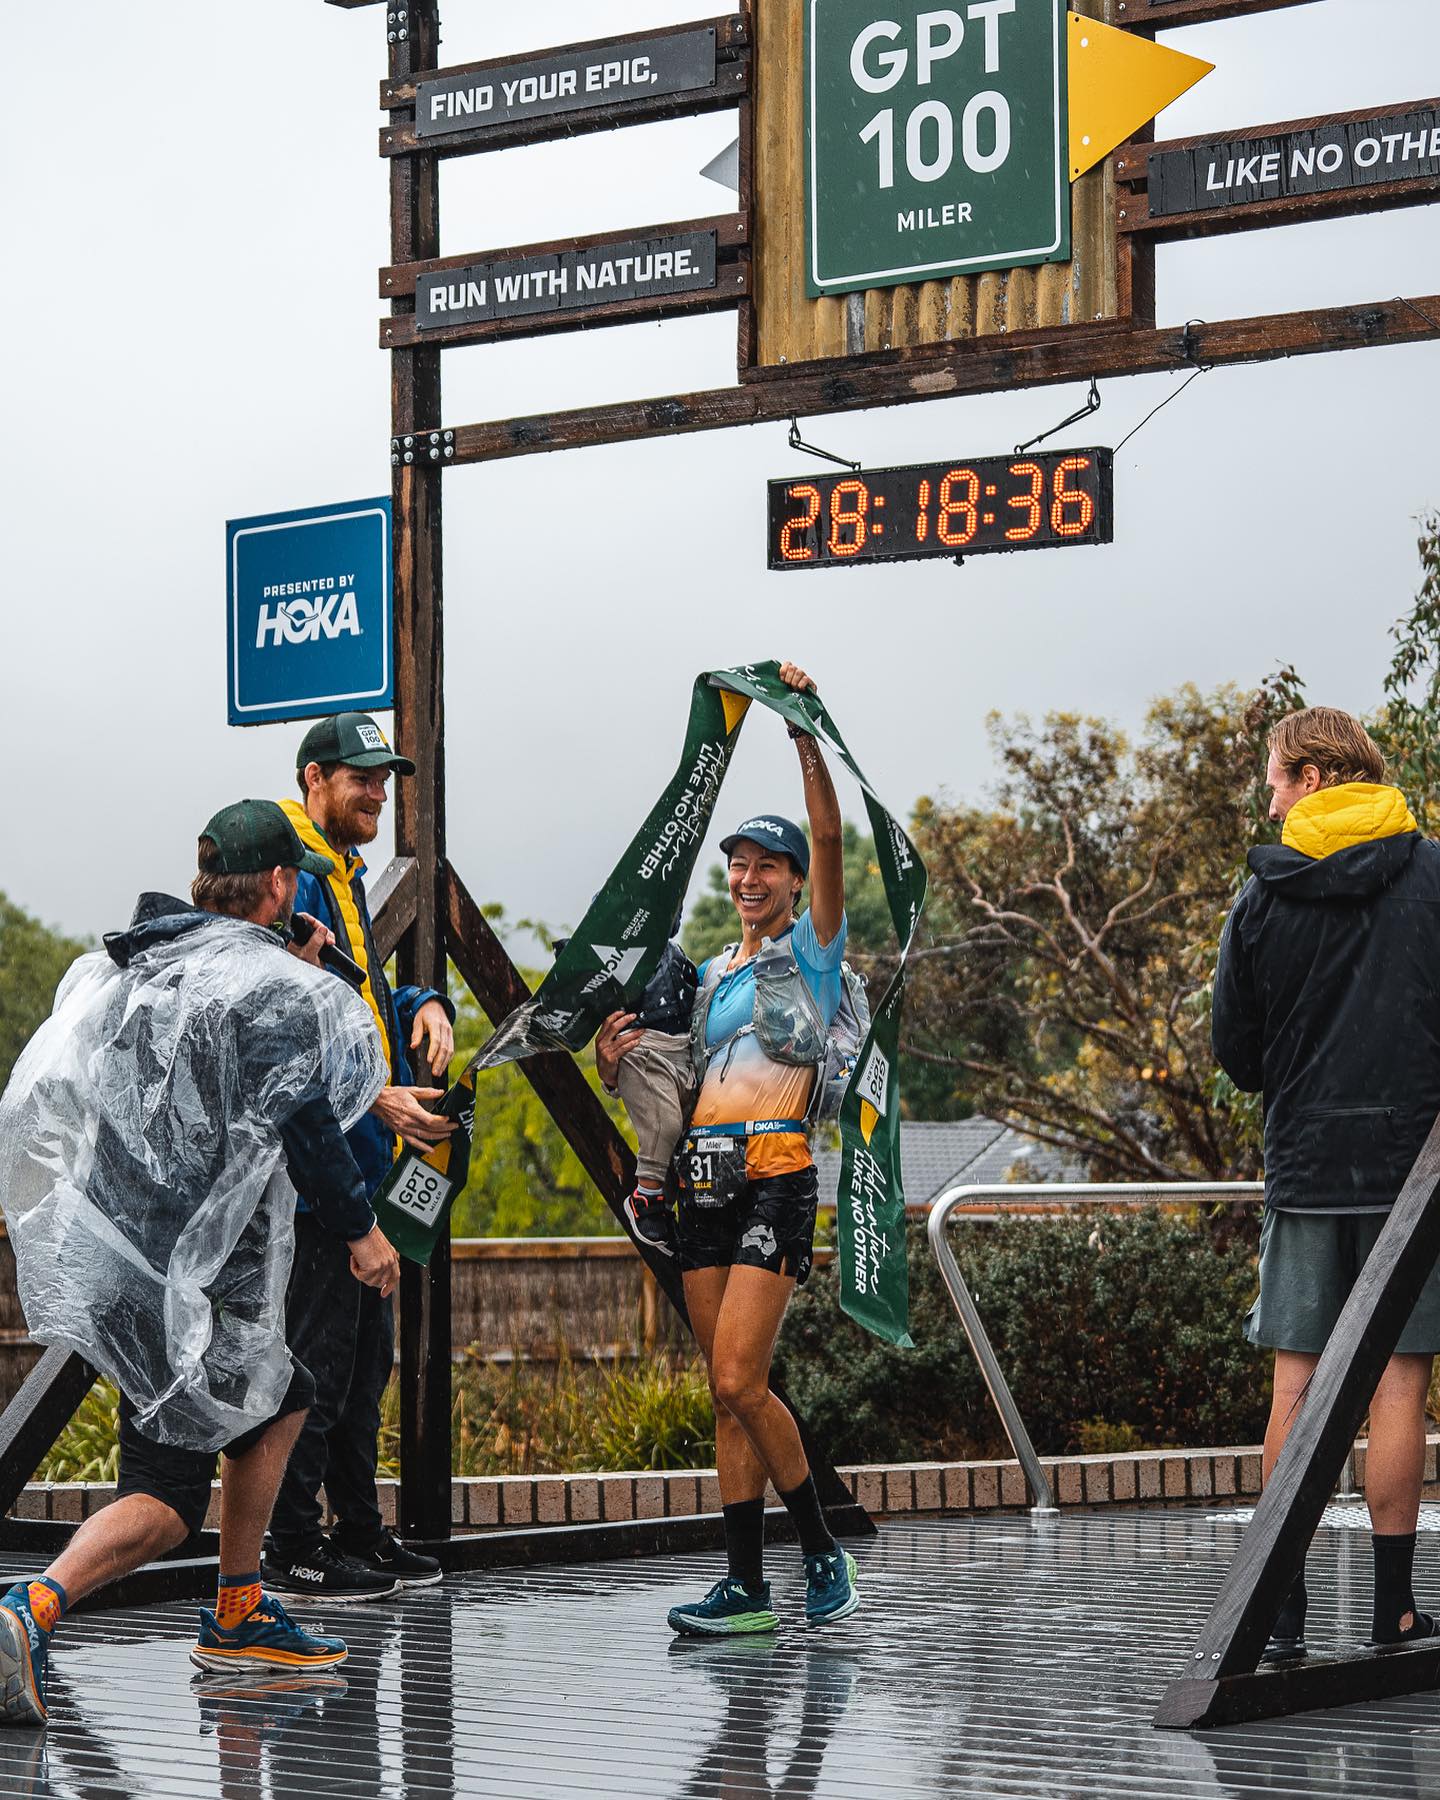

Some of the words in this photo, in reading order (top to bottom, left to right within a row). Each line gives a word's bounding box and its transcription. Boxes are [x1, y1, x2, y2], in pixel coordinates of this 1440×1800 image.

[850, 0, 1016, 94] GPT
[430, 85, 494, 120] FIND
[500, 69, 577, 106] YOUR
[585, 56, 658, 92] EPIC,
[858, 90, 1011, 189] 100
[1206, 152, 1280, 191] LIKE
[1290, 144, 1343, 178] NO
[897, 202, 973, 233] MILER
[429, 279, 487, 313] RUN
[495, 267, 568, 304] WITH
[576, 249, 700, 291] NATURE.
[780, 458, 1094, 560] 28:18:36
[263, 577, 334, 598] PRESENTED
[339, 574, 355, 587] BY
[255, 591, 361, 649] HOKA
[689, 743, 713, 787] LIKE
[674, 788, 695, 817] NO
[637, 820, 679, 880] OTHER
[737, 820, 784, 838] HOKA
[620, 908, 645, 940] PARTNER
[631, 910, 651, 937] MAJOR
[580, 946, 629, 994] VICTORIA
[870, 1055, 881, 1096] 100
[754, 1122, 775, 1131] OKA
[398, 1166, 426, 1205] GPT
[690, 1154, 712, 1181] 31
[851, 1148, 865, 1195] LIKE
[411, 1177, 438, 1213] 100
[850, 1195, 865, 1224] NO
[860, 1149, 891, 1295] Adventure
[853, 1229, 867, 1295] OTHER
[289, 1564, 325, 1583] HOKA
[17, 1605, 40, 1652] HOKA
